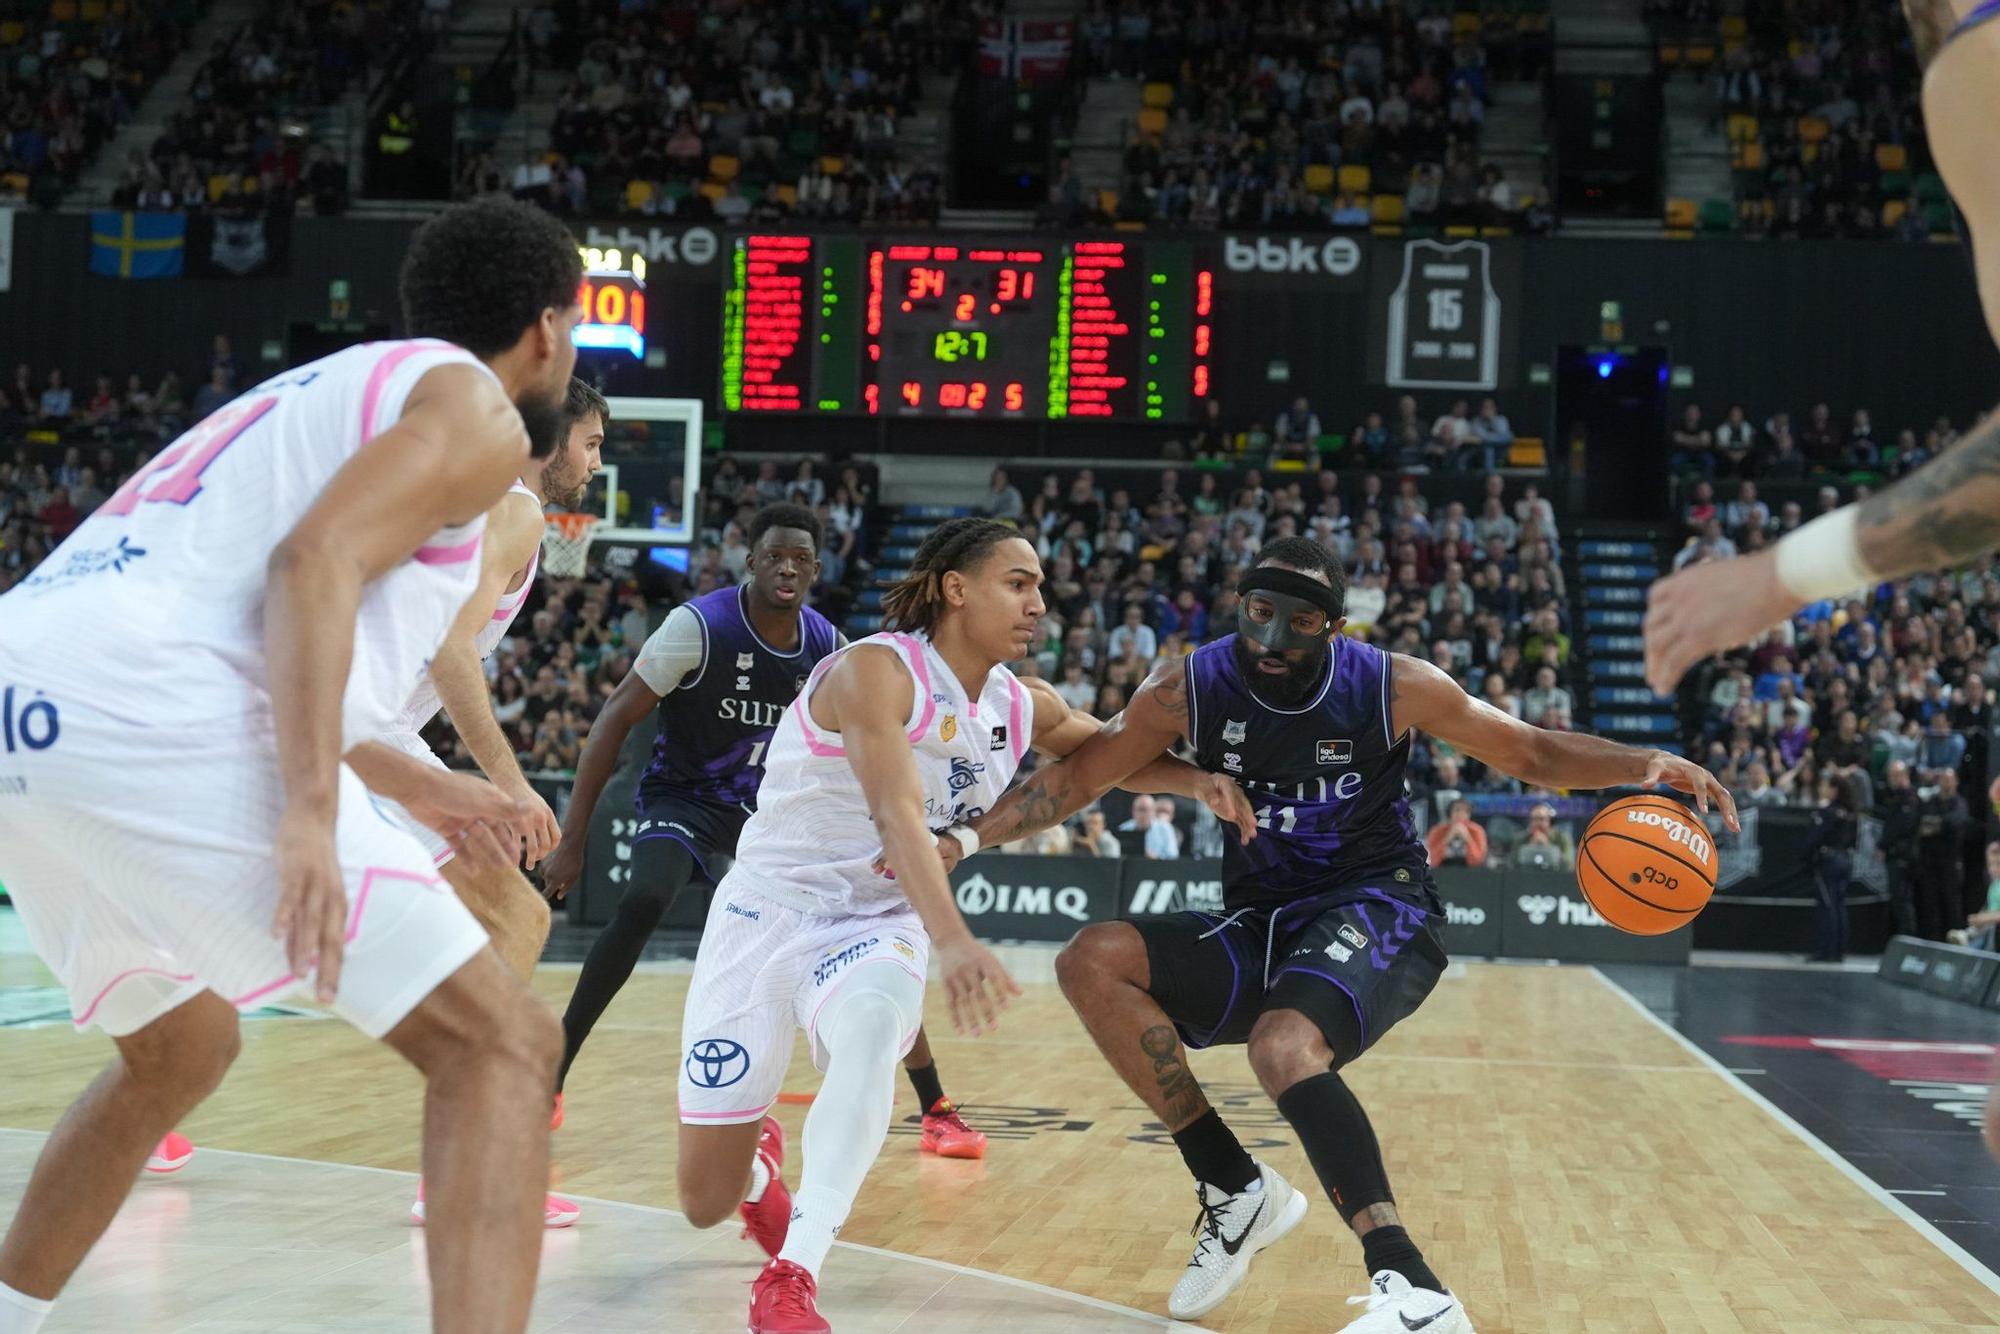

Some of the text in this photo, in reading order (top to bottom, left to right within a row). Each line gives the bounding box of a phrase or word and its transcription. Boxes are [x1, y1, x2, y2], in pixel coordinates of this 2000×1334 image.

[1225, 237, 1318, 271] bbk
[909, 268, 944, 298] 34
[998, 270, 1033, 300] 31
[956, 295, 975, 321] 2
[1429, 290, 1463, 329] 15
[903, 382, 920, 406] 4
[1006, 383, 1022, 410] 5
[718, 697, 788, 727] sur
[747, 740, 767, 767] 1
[1320, 753, 1349, 761] endesa
[1626, 810, 1709, 865] Wilson
[1643, 866, 1678, 890] acb
[995, 885, 1089, 920] IMQ
[1559, 895, 1609, 927] hu
[1341, 929, 1359, 943] acb
